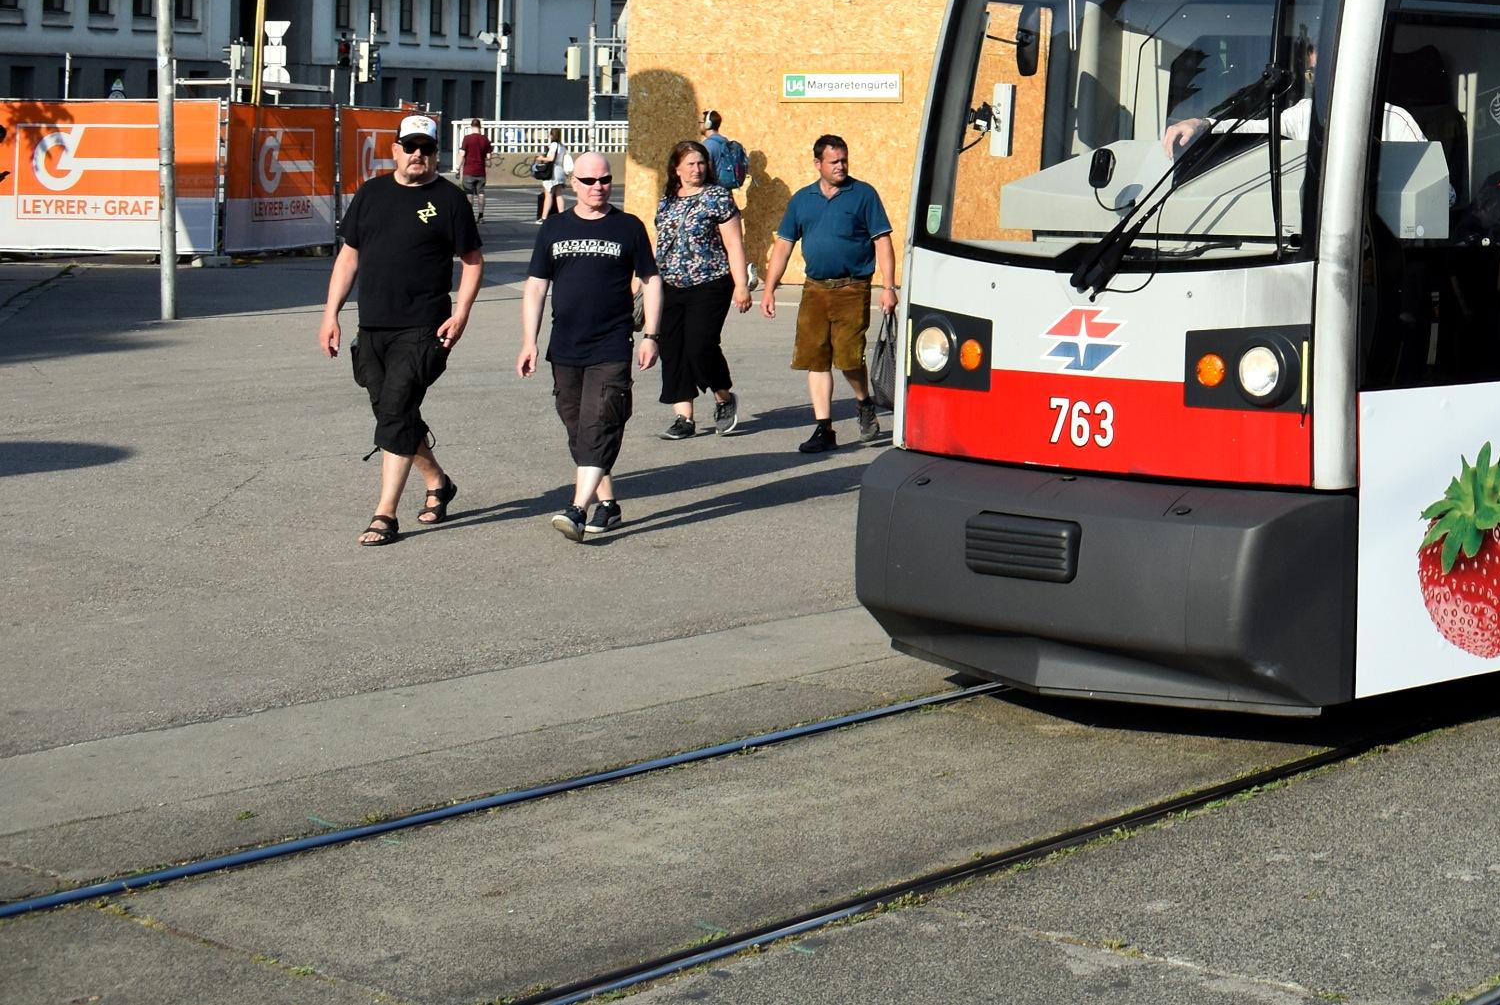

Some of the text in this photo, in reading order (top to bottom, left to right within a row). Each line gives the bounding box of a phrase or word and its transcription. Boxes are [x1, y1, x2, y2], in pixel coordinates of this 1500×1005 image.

[786, 79, 898, 92] U4 Margaretengürtel
[22, 199, 87, 215] LEYRER
[104, 200, 154, 216] GRAF
[254, 201, 284, 217] LEYRER
[290, 199, 312, 215] GRAF
[1048, 396, 1114, 448] 763
